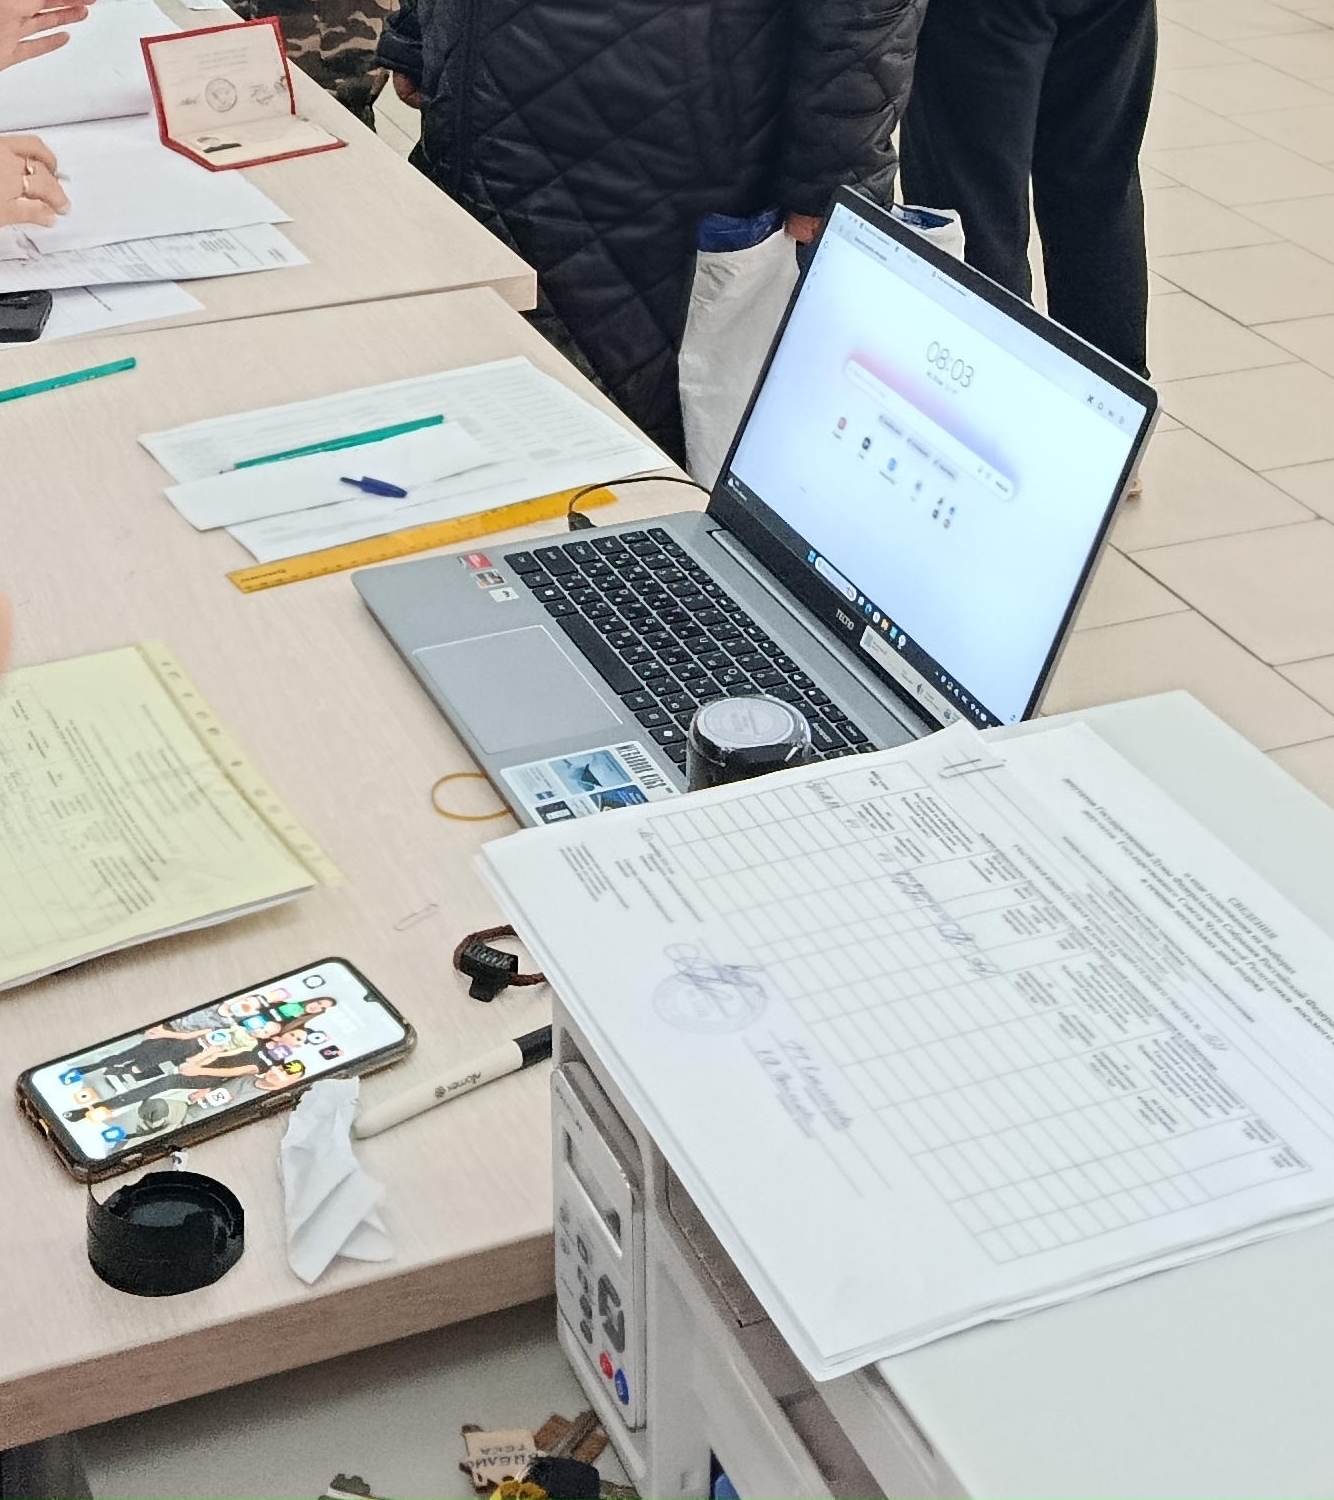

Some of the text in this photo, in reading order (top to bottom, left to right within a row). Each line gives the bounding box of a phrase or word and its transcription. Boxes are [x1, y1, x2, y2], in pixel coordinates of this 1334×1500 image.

[927, 341, 974, 387] 08:03
[836, 608, 855, 630] TECNO
[1093, 806, 1157, 857] Государственной
[1148, 857, 1177, 877] Думы
[1169, 877, 1227, 923] Федерального
[1219, 923, 1264, 957] Собрания
[1257, 957, 1310, 999] Российской
[1113, 841, 1183, 898] Государственного
[1175, 897, 1207, 921] Совета
[1200, 921, 1250, 960] Чувашской
[1243, 961, 1296, 1003] Республики
[1290, 1005, 1334, 1040] восьмого
[1144, 883, 1177, 909] течение
[1171, 909, 1219, 948] нескольких
[1232, 966, 1265, 992] подряд
[1204, 893, 1254, 934] голосования
[1258, 944, 1298, 975] выборах
[1225, 897, 1278, 939] СВЕДЕНИЯ
